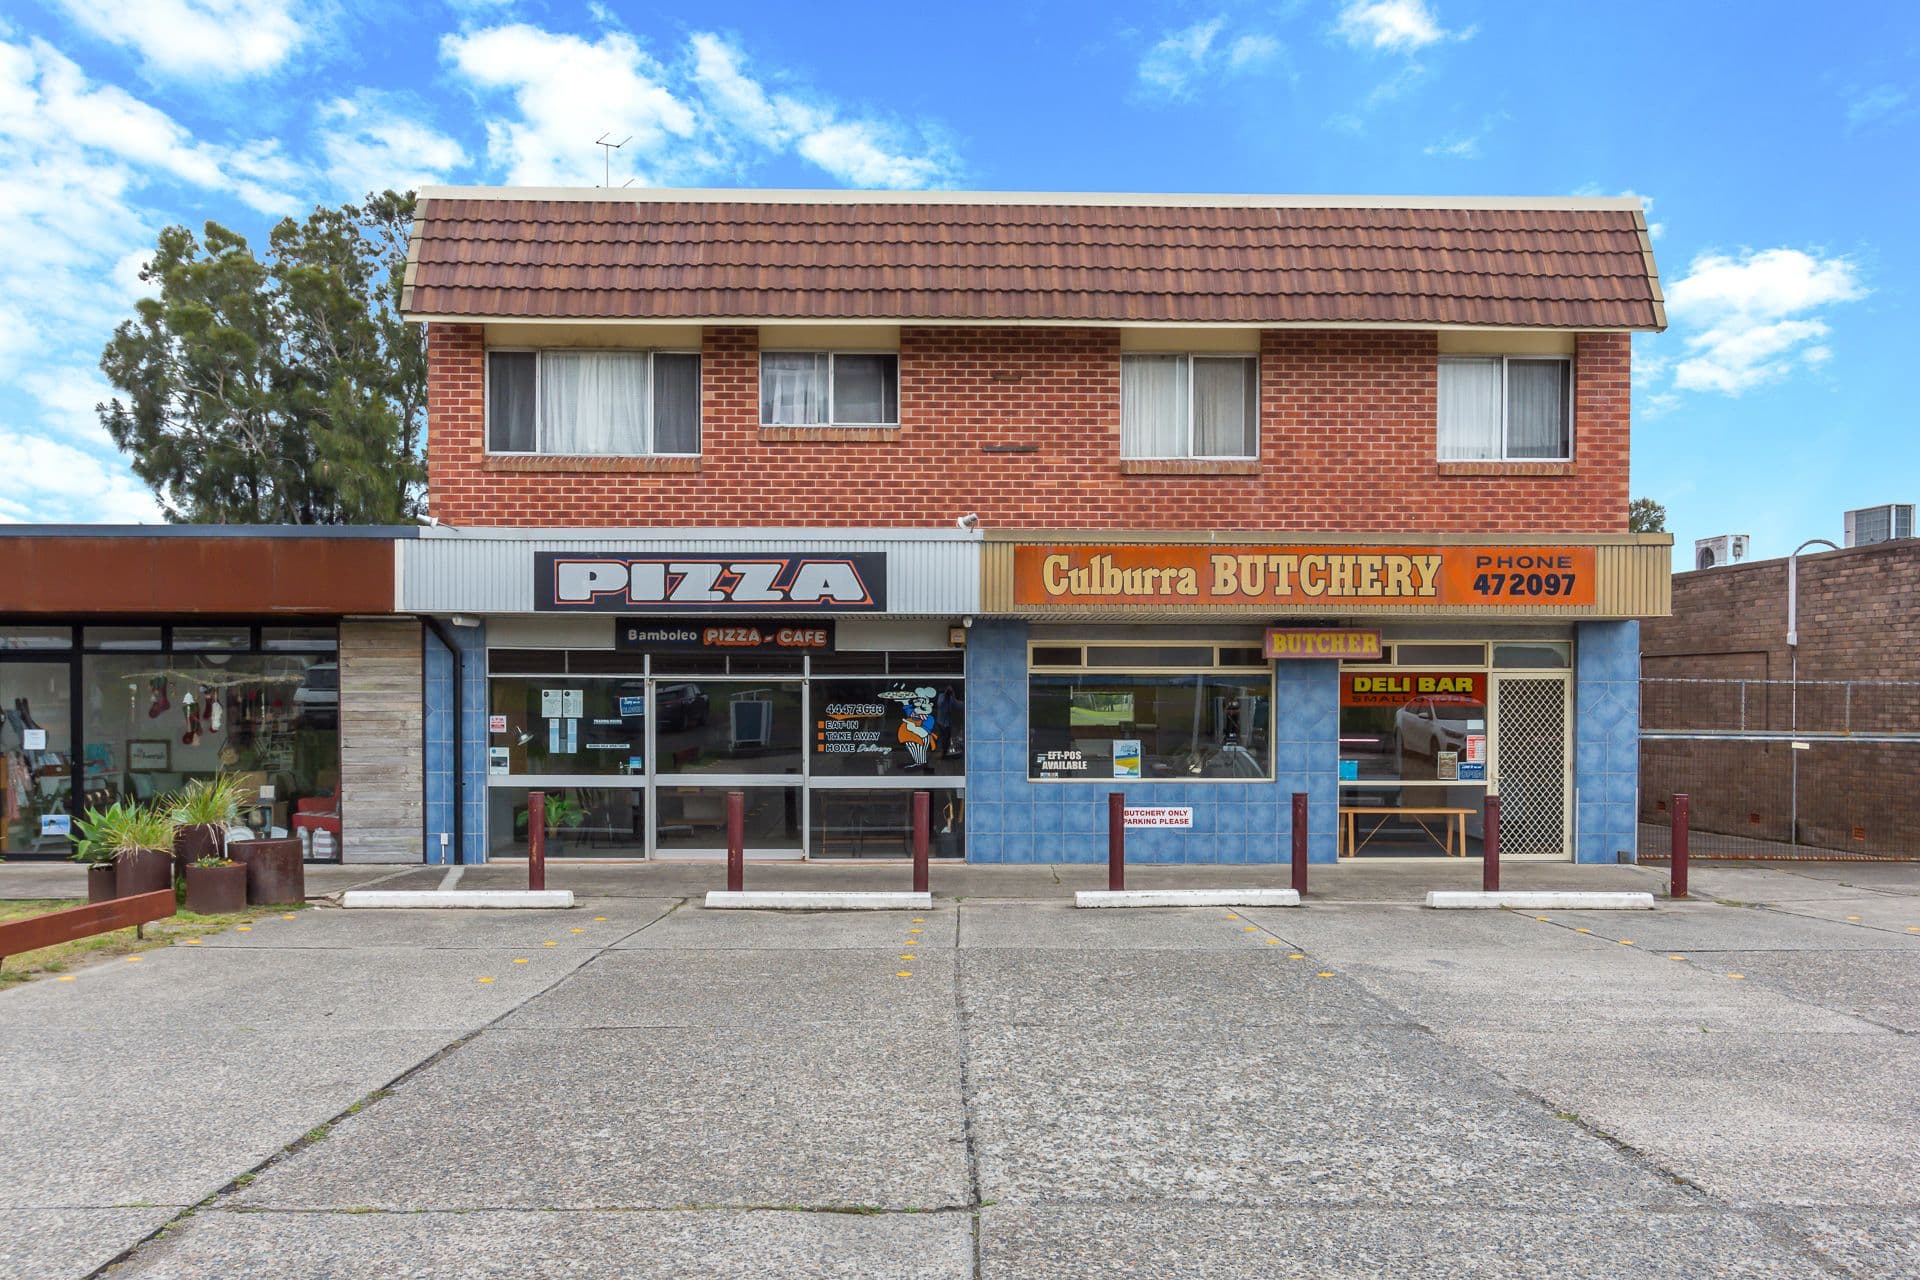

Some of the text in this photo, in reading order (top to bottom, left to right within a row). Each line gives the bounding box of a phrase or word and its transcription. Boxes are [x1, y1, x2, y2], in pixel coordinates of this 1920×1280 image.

[1475, 555, 1572, 569] PHONE
[556, 561, 871, 603] PIZZA
[1042, 553, 1443, 597] Culburra BUTCHERY
[1473, 573, 1576, 596] 472097
[628, 628, 697, 641] Bamboleo
[705, 628, 762, 644] PIZZA
[778, 629, 827, 645] CAFE
[1272, 633, 1379, 654] BUTCHER
[1353, 676, 1474, 693] DELI BAR
[825, 731, 880, 741] TAKE AWAY
[825, 743, 856, 753] HOME
[1047, 750, 1082, 760] EFT-POS
[1041, 760, 1088, 770] AVAILABLE
[1124, 809, 1188, 817] BUTCHERY ONLY
